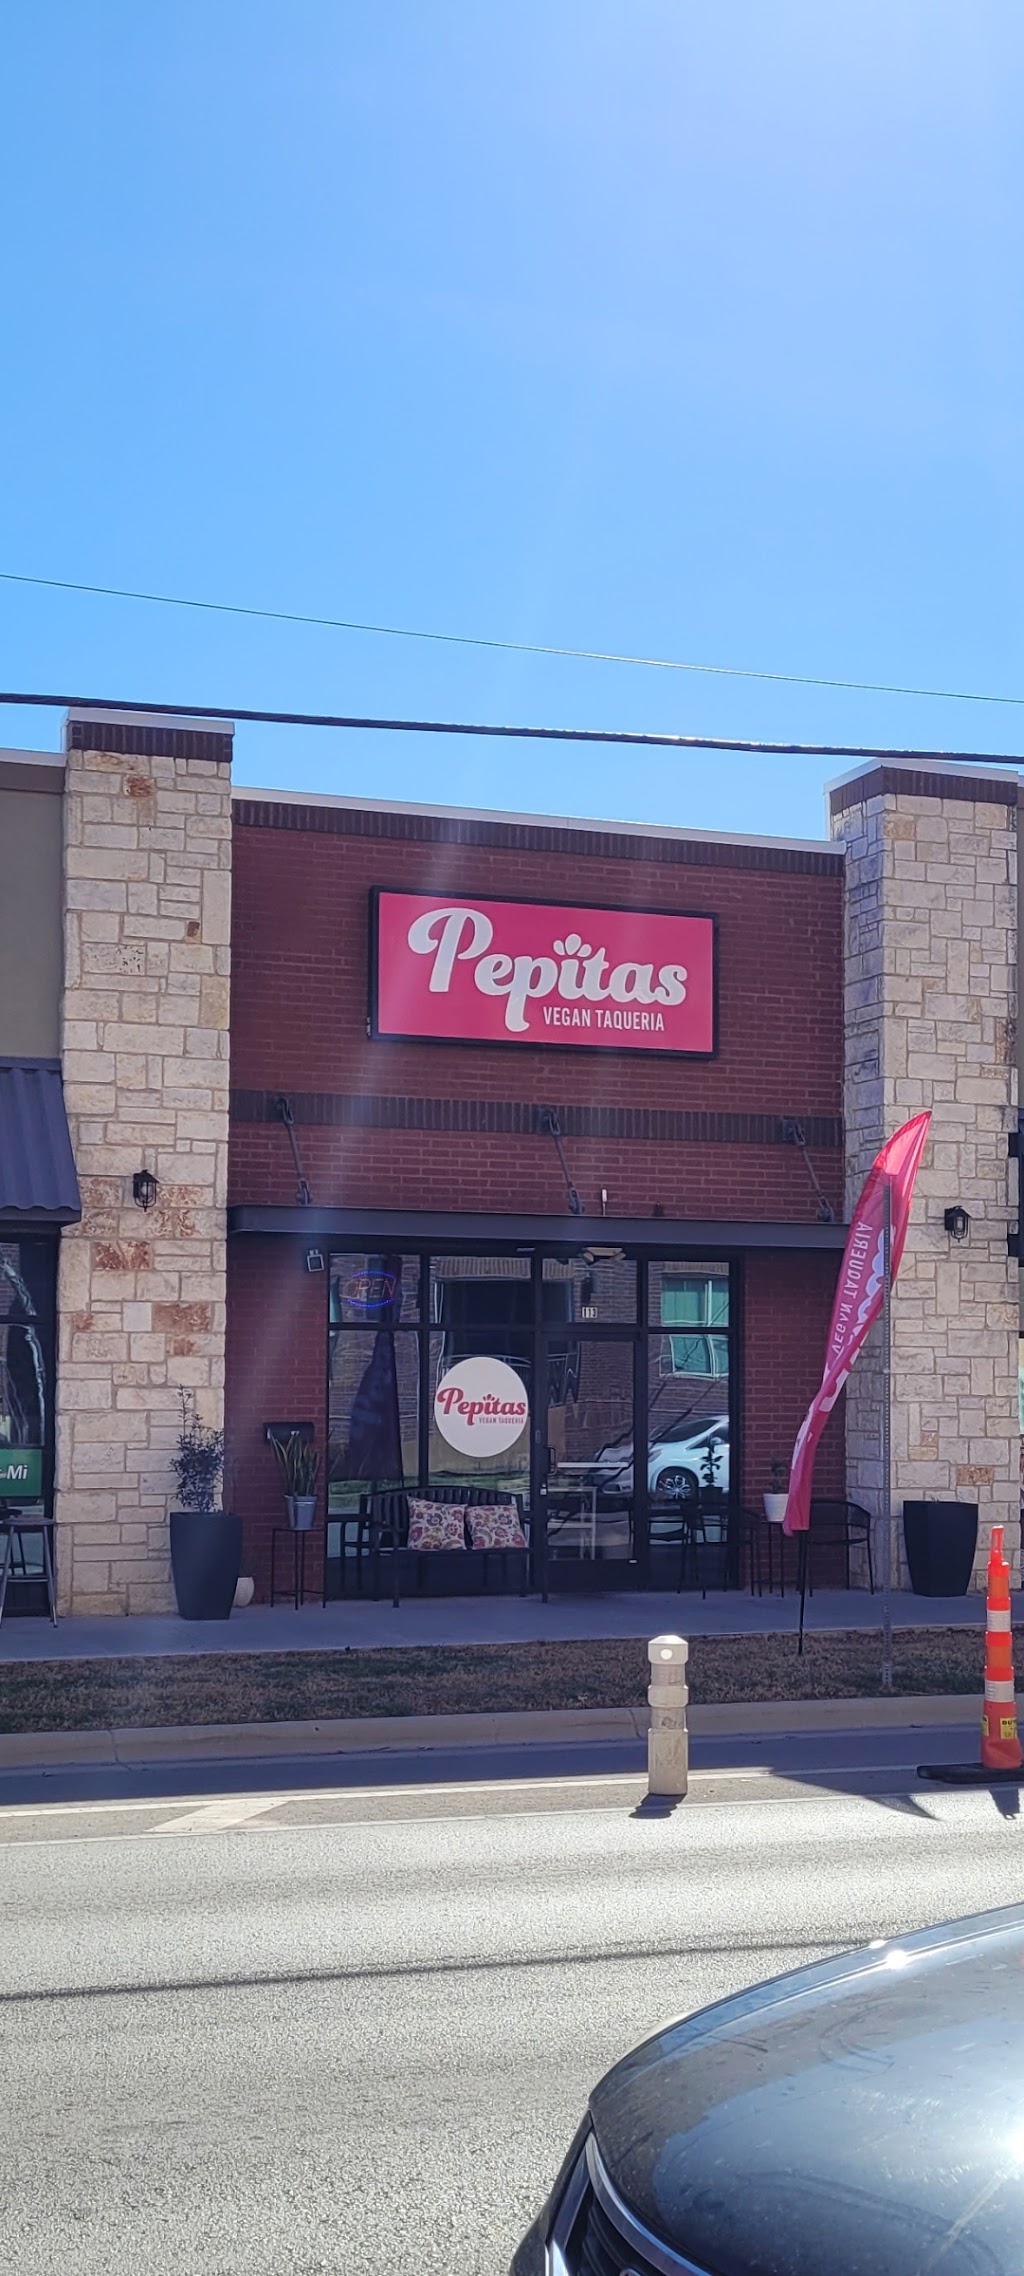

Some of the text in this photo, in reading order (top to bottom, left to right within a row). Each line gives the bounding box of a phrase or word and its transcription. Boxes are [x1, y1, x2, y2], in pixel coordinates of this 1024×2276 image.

[408, 908, 687, 1032] Pepitas
[543, 1006, 664, 1031] VEGAN TAQUERIA
[343, 1278, 396, 1298] OPEN
[582, 1306, 598, 1319] 113
[437, 1387, 526, 1426] Pepitas
[498, 1417, 524, 1425] TAQUERIA
